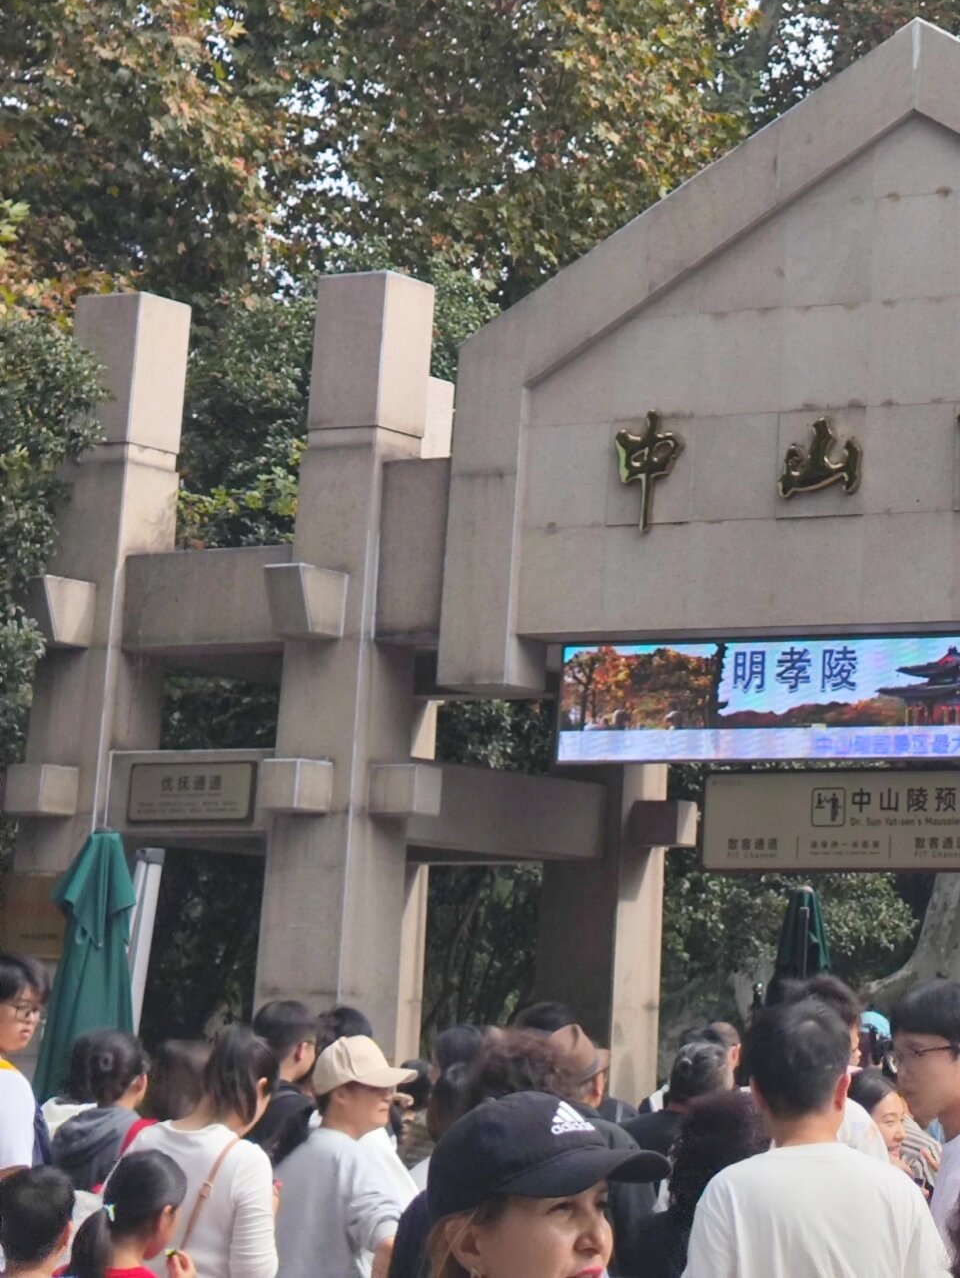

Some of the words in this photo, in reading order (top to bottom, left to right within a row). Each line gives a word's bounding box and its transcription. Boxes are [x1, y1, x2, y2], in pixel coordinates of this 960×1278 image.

[733, 646, 857, 692] 明孝陵
[866, 817, 881, 826] Sun
[728, 837, 778, 851] 散客通道
[551, 1121, 595, 1135] adidas
